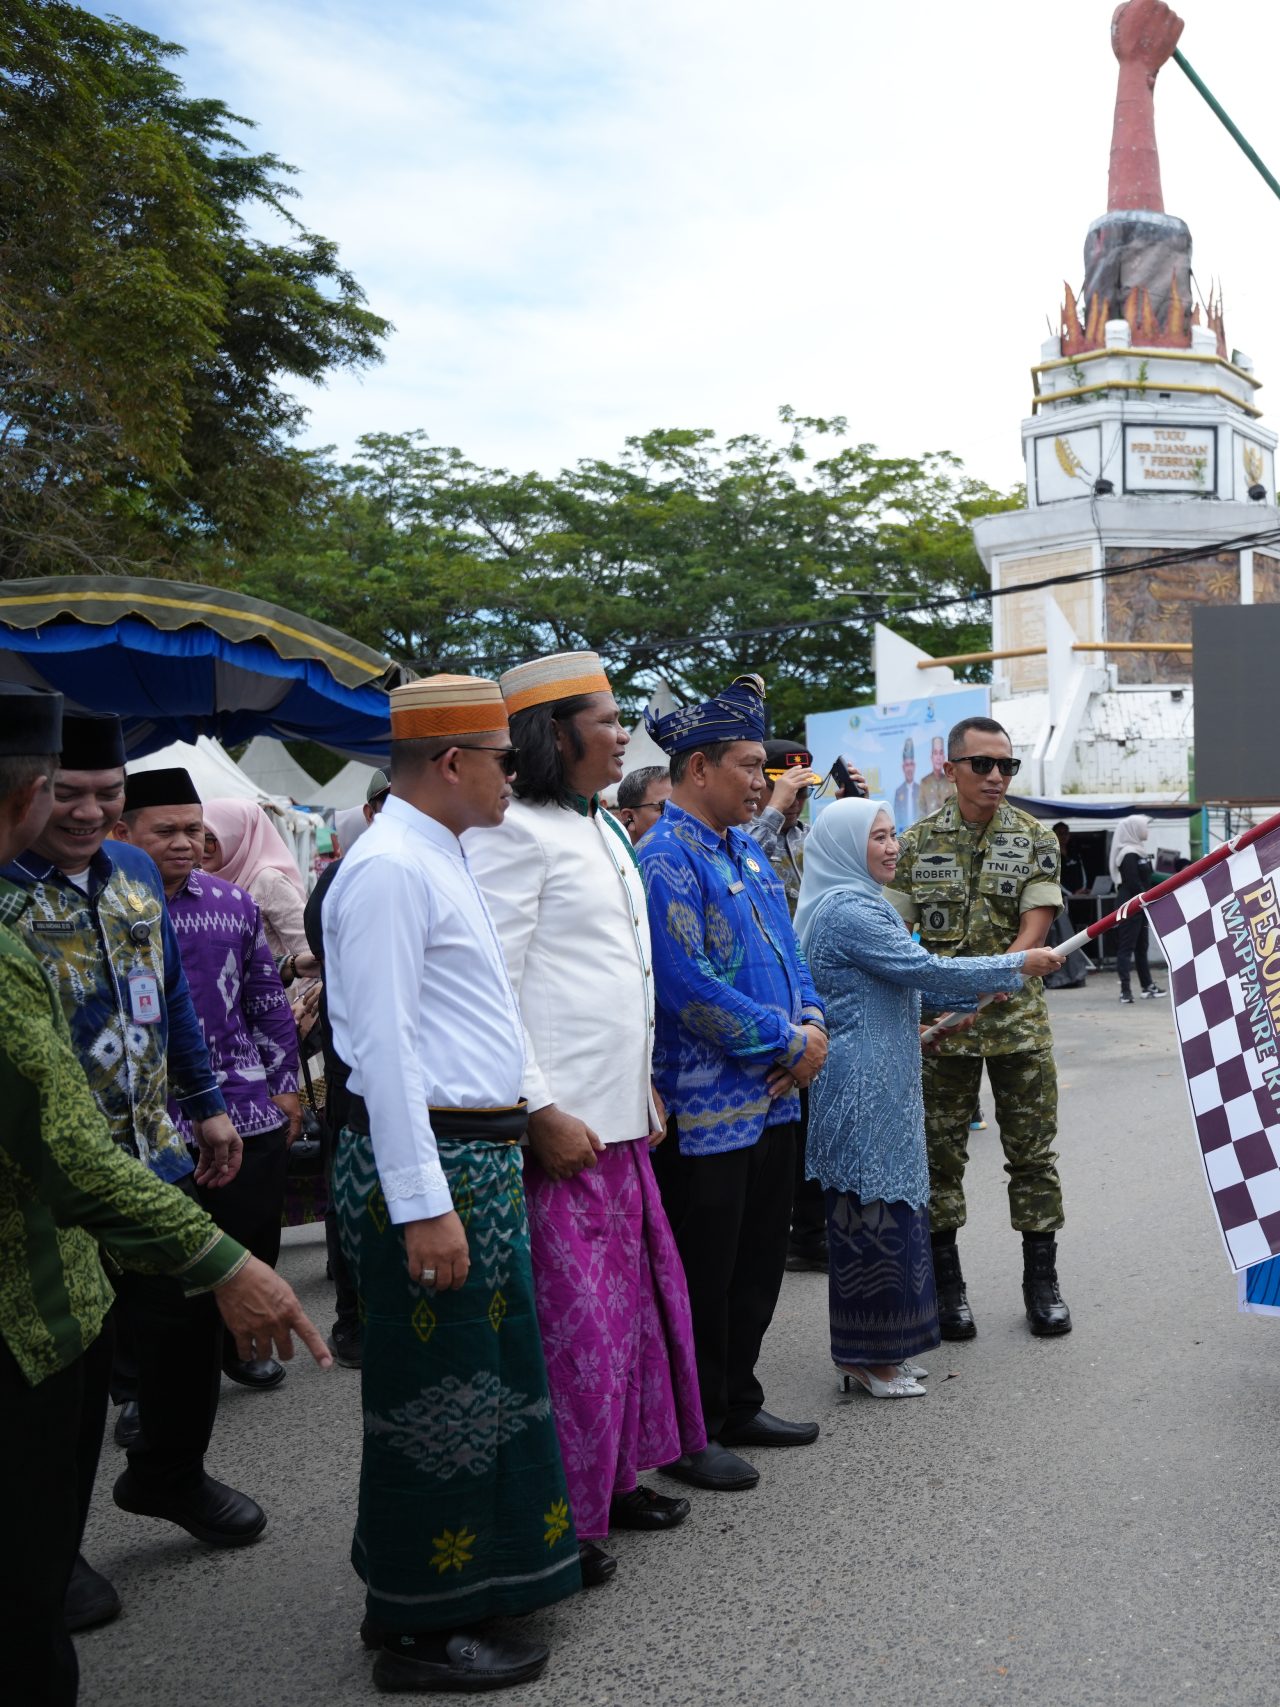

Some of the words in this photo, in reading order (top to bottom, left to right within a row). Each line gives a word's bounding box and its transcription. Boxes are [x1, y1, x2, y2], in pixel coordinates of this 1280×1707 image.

[1153, 430, 1187, 441] TUGU
[1131, 443, 1208, 455] PERJUANGAN
[1139, 455, 1147, 465] 7
[915, 869, 959, 879] ROBERT
[986, 862, 1008, 872] TNI
[1011, 864, 1030, 875] AD
[1221, 898, 1277, 1063] MAPPANRE
